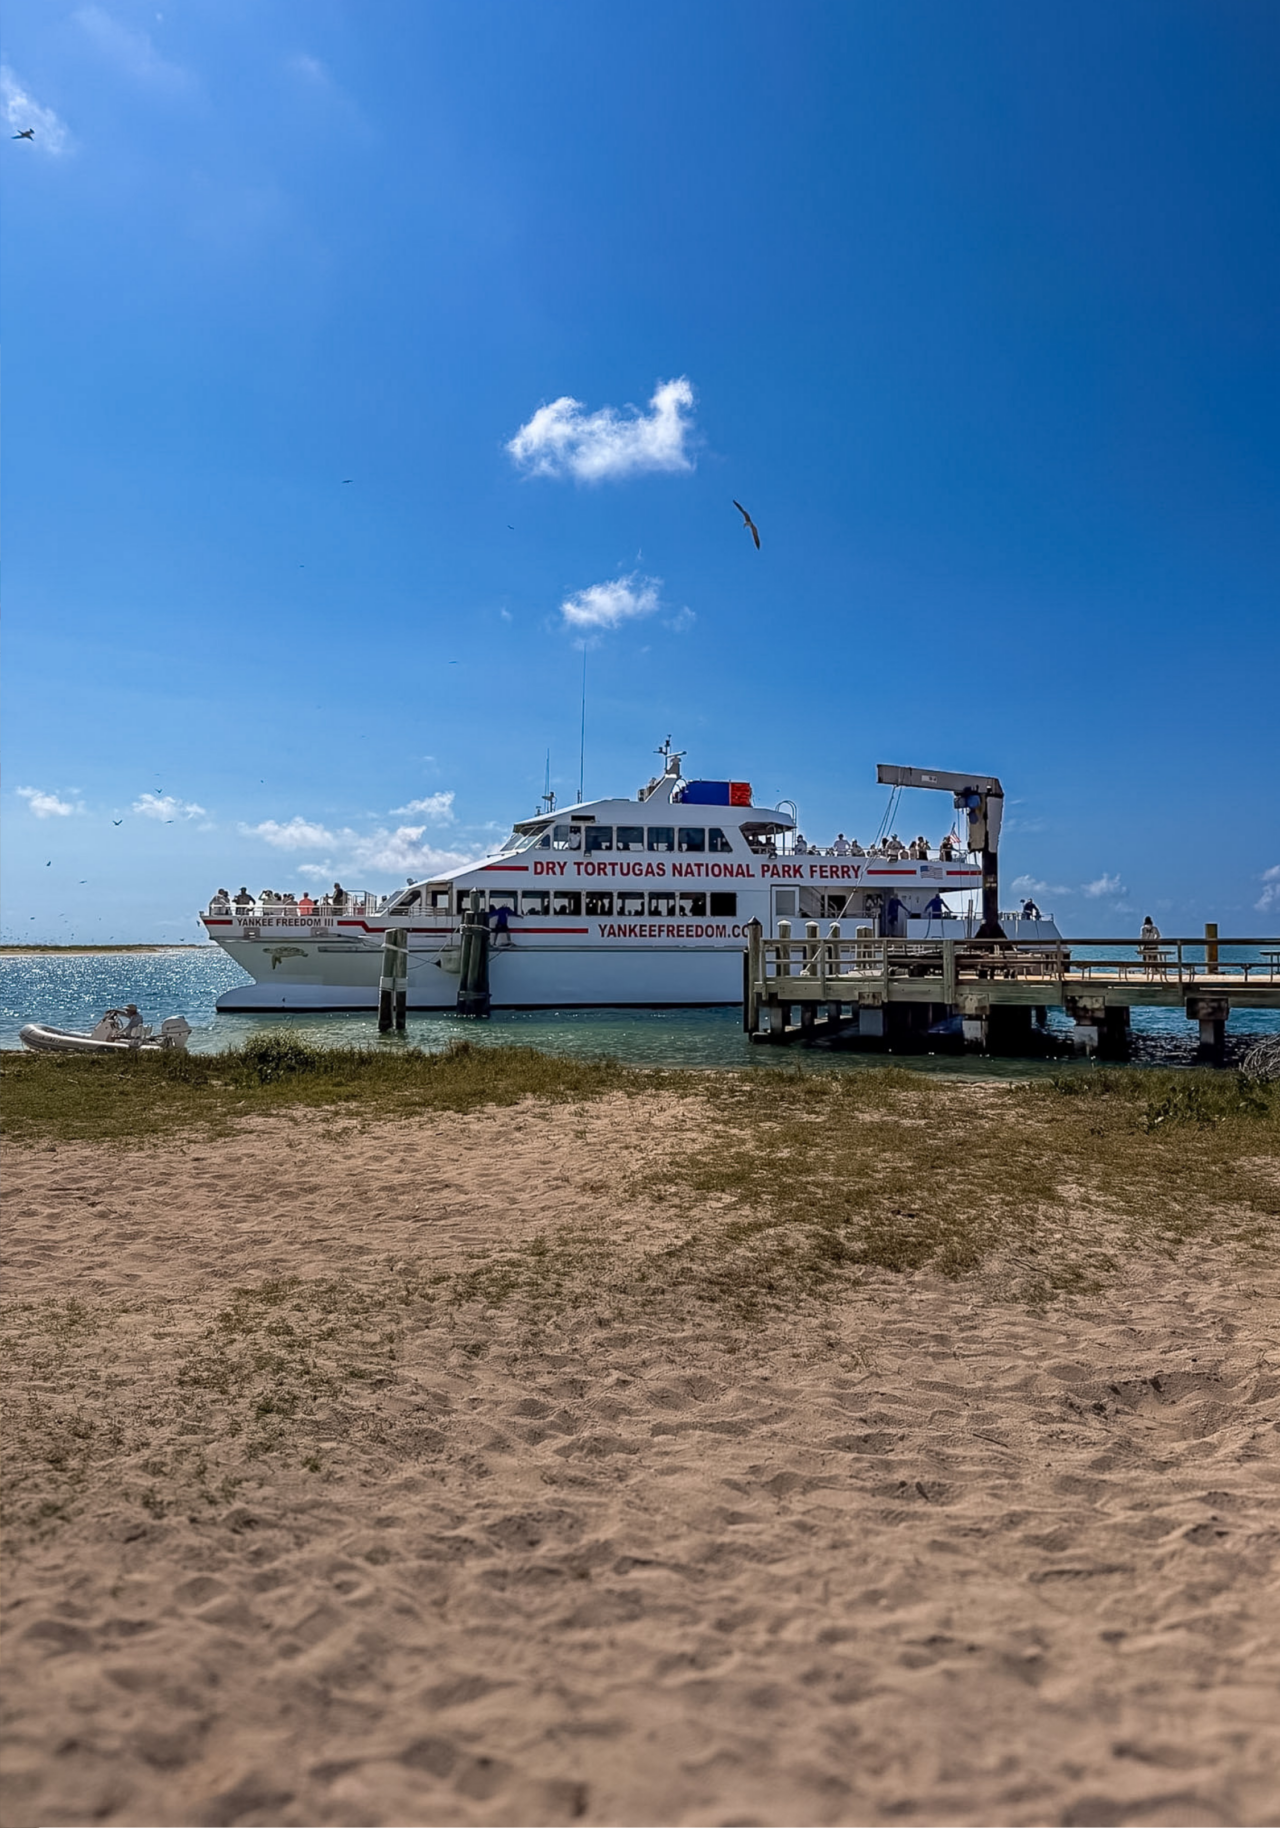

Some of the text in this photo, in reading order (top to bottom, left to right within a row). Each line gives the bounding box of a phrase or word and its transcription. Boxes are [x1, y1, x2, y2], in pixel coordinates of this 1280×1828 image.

[533, 861, 861, 879] DRY TORTUGAS NATIONAL PARK FERRY
[237, 918, 334, 927] YANKEE FREEDOM III
[598, 923, 762, 939] YANKEEFREEDOM.CO
